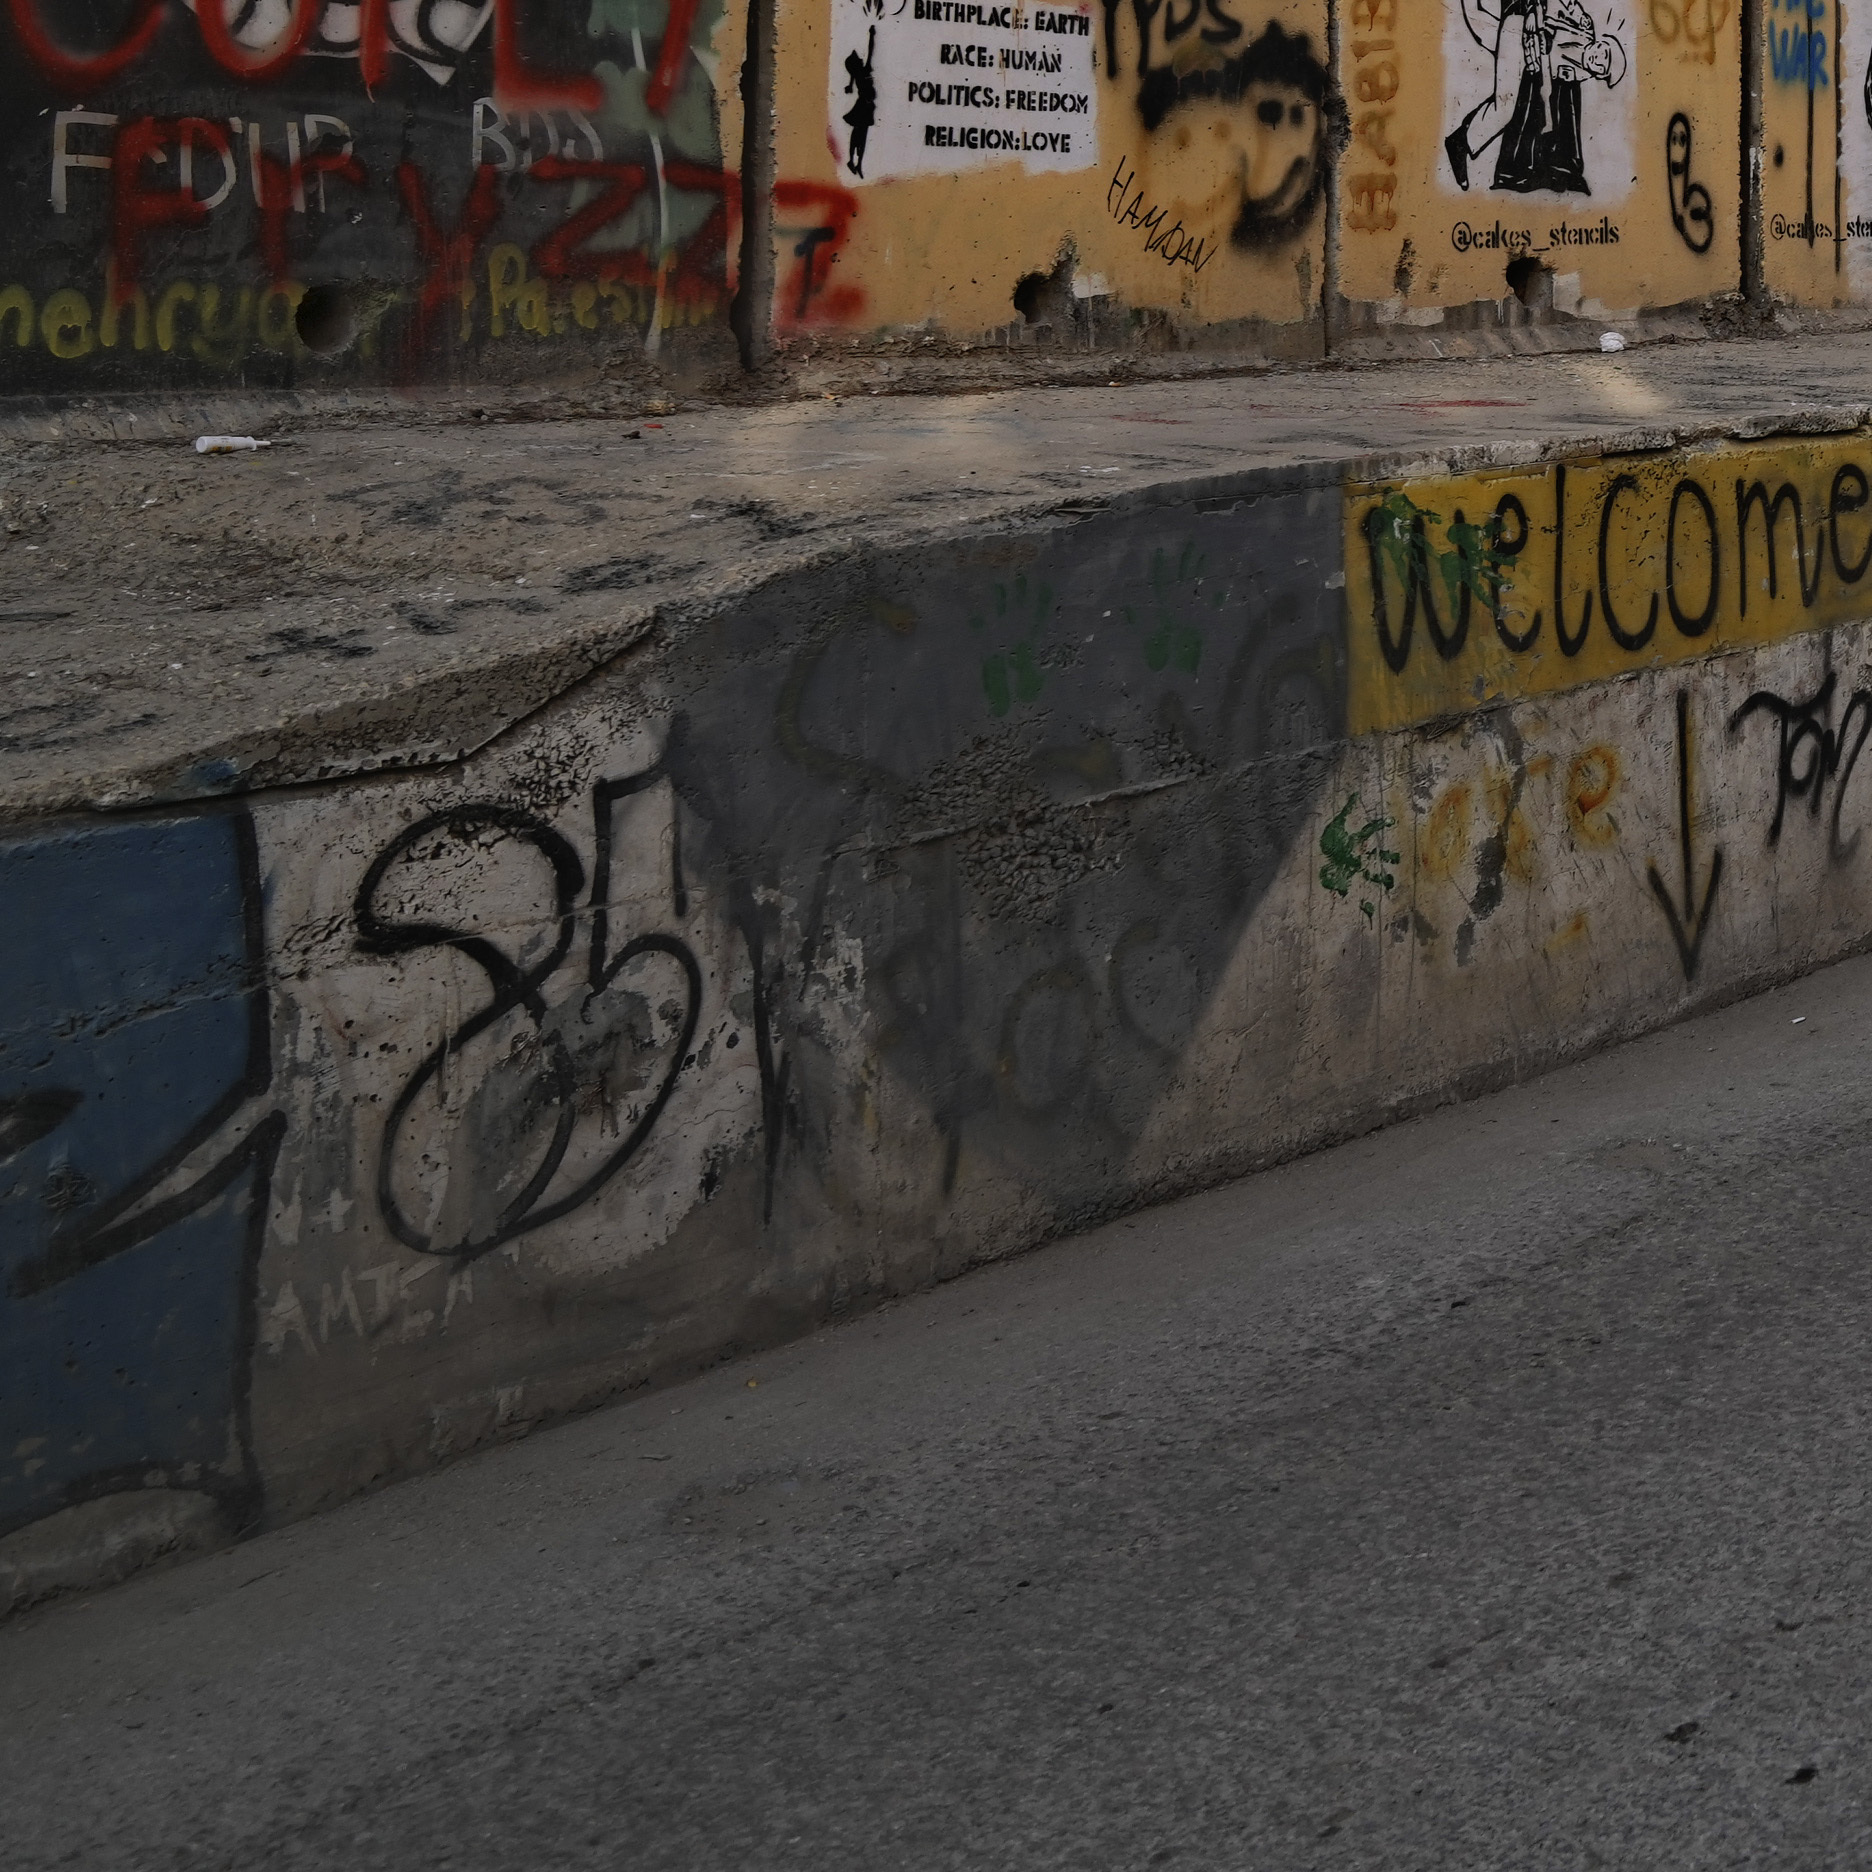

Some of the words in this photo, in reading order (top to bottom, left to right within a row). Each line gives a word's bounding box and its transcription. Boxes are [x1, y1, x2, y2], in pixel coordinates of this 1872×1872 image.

[914, 0, 1029, 30] BIRTHPLACE:
[1034, 7, 1090, 35] EARTH
[940, 44, 994, 68] RACE:
[1000, 48, 1062, 72] HUMAN
[908, 82, 1000, 109] POLITICS:
[1005, 89, 1088, 115] FREEDOM
[1106, 155, 1217, 272] HAMDAN
[1452, 217, 1619, 252] @cakes_stencils
